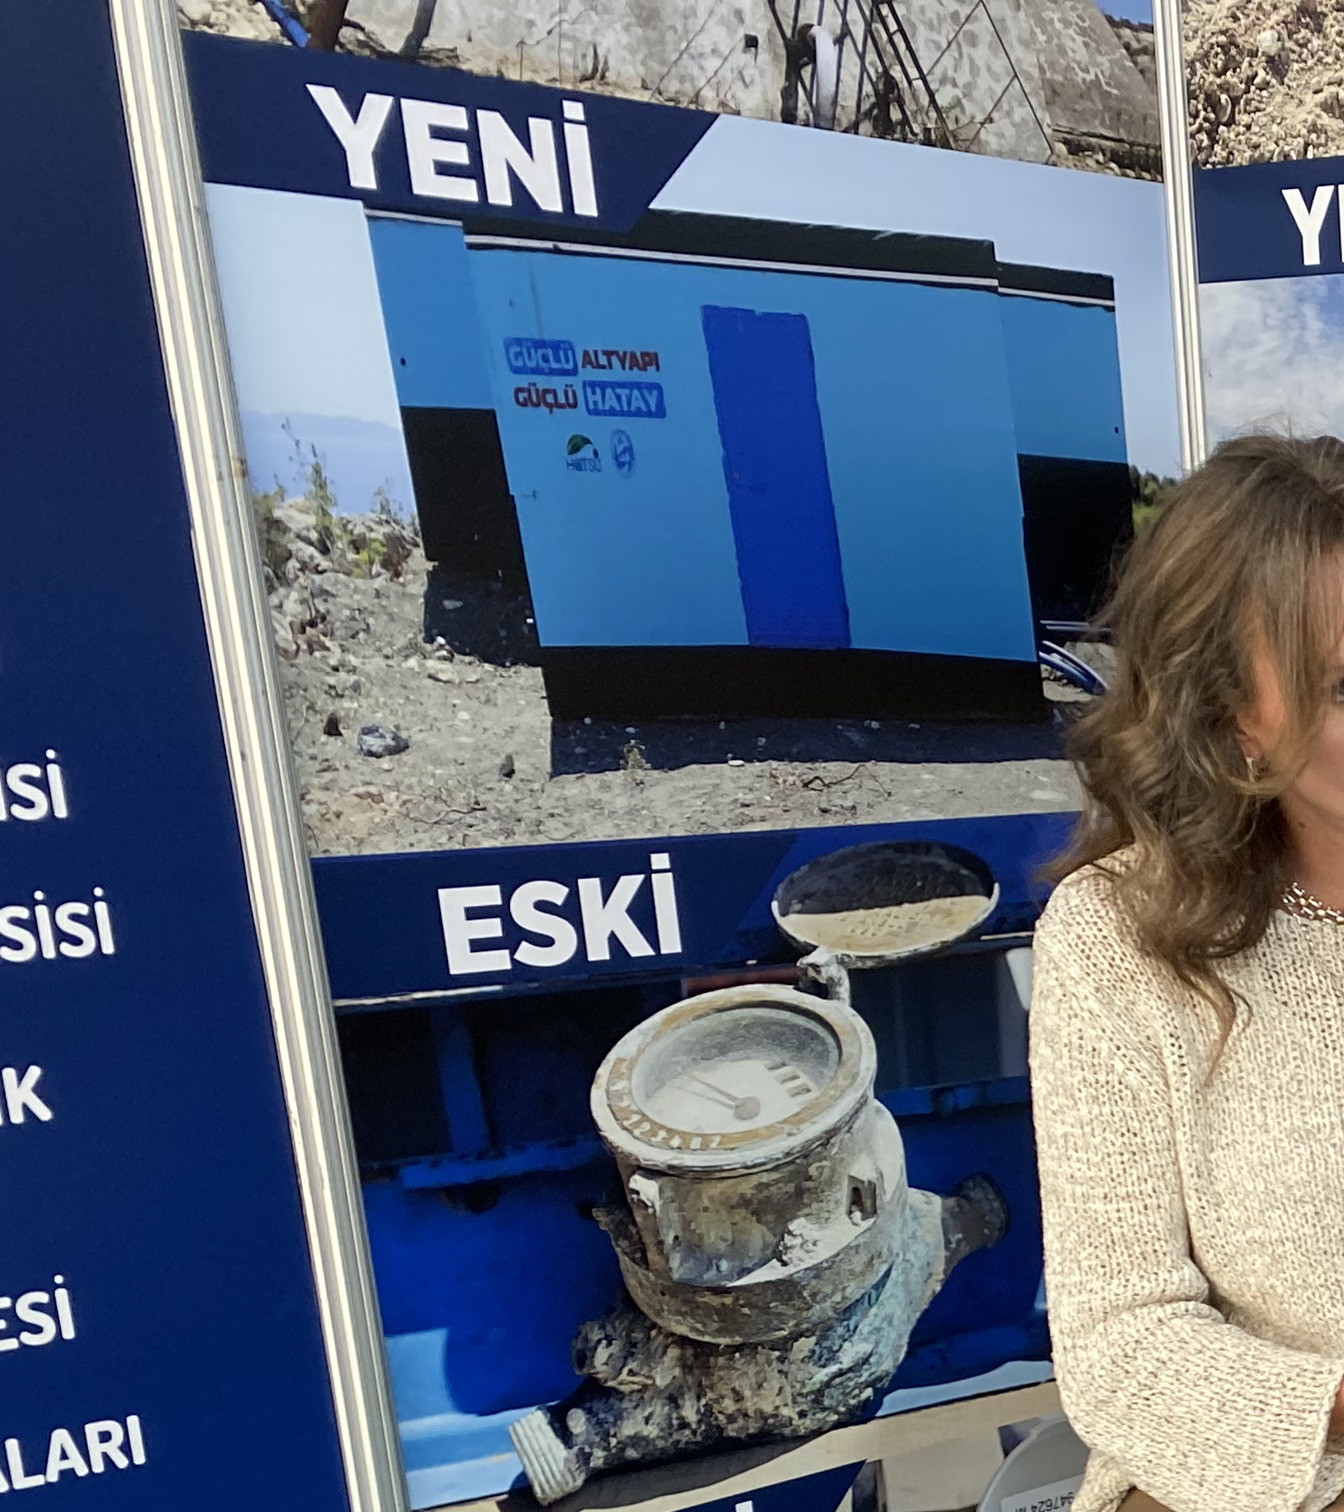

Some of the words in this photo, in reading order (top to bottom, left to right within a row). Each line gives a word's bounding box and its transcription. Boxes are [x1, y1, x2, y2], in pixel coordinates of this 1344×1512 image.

[308, 84, 599, 217] YENİ
[507, 340, 575, 372] GÜÇLÜ
[581, 349, 660, 372] ALTYAPI
[514, 382, 578, 414] GÜÇLÜ
[586, 386, 658, 412] HATAY
[0, 749, 68, 822] Sİ
[437, 852, 683, 976] ESKİ
